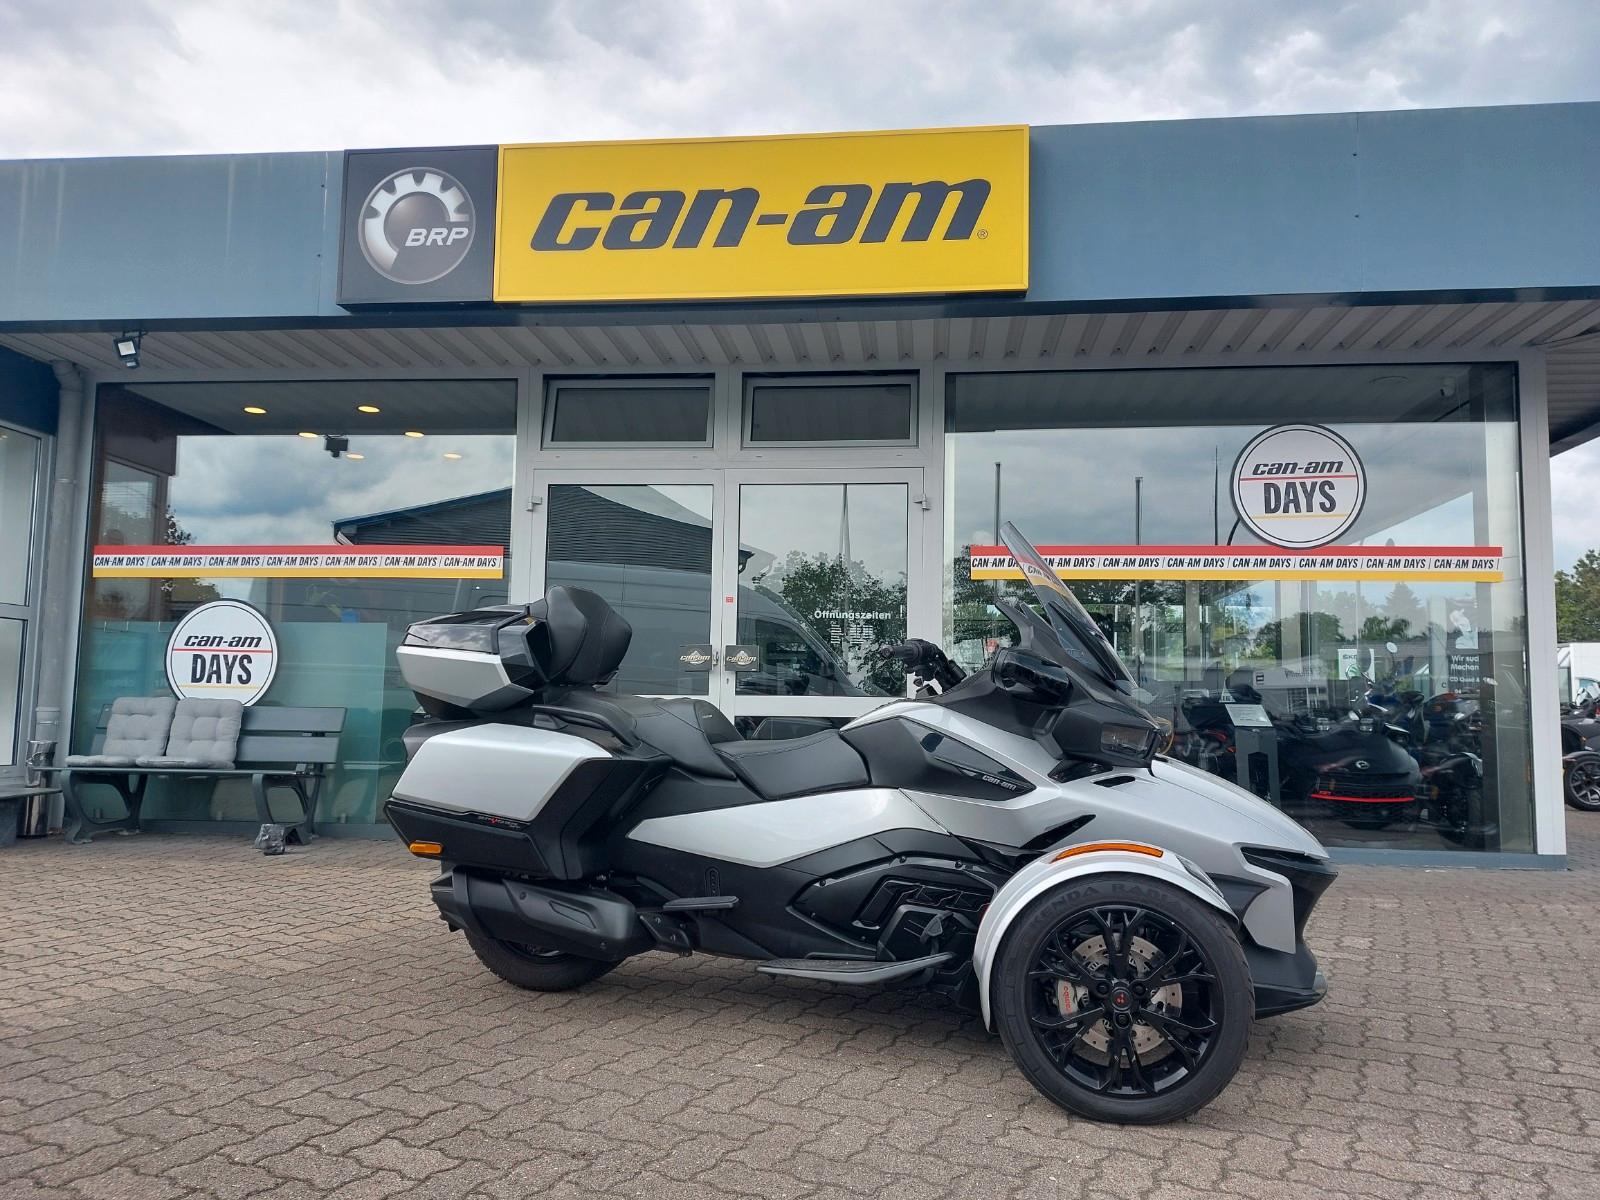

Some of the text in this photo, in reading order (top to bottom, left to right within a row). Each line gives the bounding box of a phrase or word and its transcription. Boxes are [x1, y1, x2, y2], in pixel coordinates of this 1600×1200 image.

[404, 227, 469, 247] BRP
[1252, 461, 1344, 476] can-am
[1263, 480, 1337, 514] DAYS
[94, 557, 497, 567] CAN-AM DAYS CAN-AM DAYS CAN-AM DAYS CAN-AM DAYS CAN-AM DAYS CAN-AM DAYS CAN-AM DAYS
[971, 558, 1006, 568] CAN-AM
[1074, 558, 1096, 568] DAYS
[1102, 558, 1136, 568] CAN-AM
[1138, 558, 1160, 568] DAYS
[1167, 558, 1201, 568] CAN-AM
[1203, 558, 1225, 568] DAYS
[1232, 558, 1266, 568] CAN-AM
[1269, 558, 1292, 568] DAYS
[1299, 558, 1333, 569] CAN-AM
[1336, 558, 1359, 569] DAYS
[1366, 558, 1401, 569] CAN-AM
[1403, 558, 1426, 569] DAYS
[1434, 558, 1469, 569] CAN-AM
[1471, 558, 1495, 569] DAYS
[184, 635, 262, 648] can-am
[190, 653, 253, 685] DAYS
